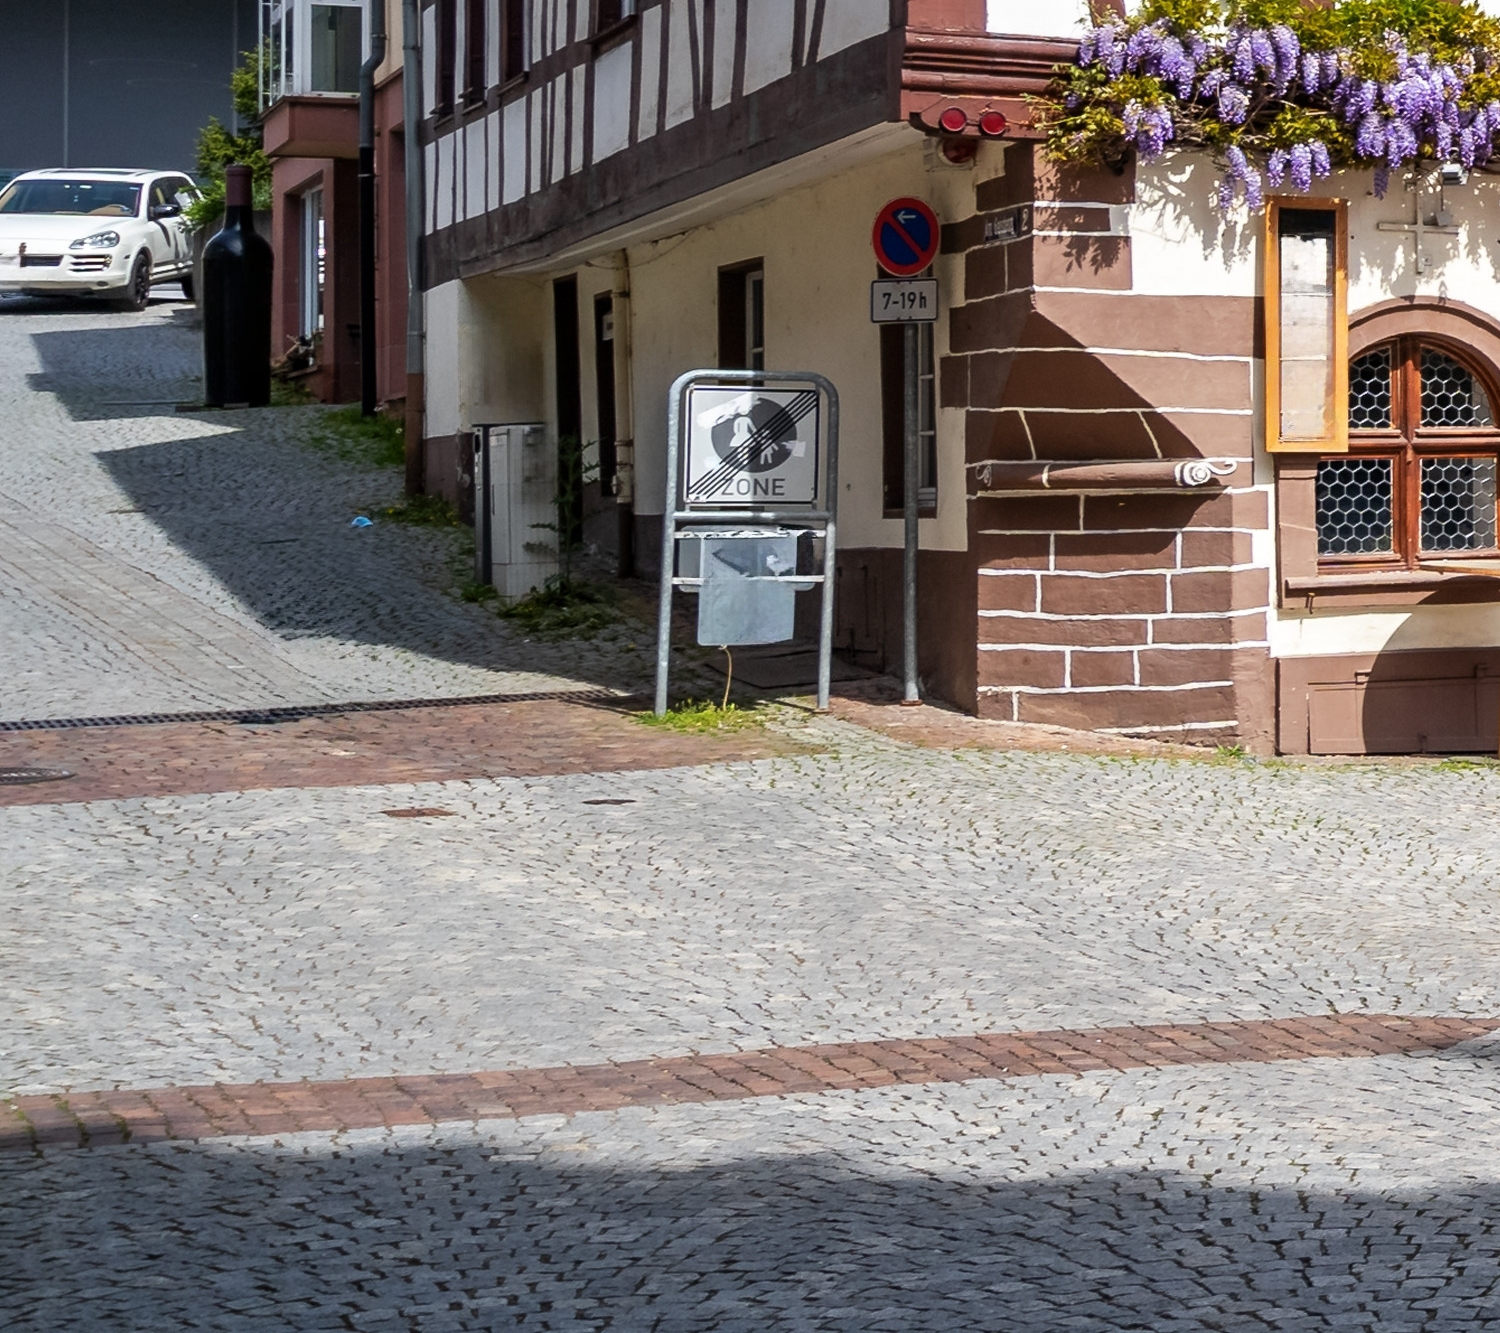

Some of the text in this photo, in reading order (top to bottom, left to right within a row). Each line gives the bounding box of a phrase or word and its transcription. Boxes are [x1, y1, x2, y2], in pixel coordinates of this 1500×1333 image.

[882, 291, 927, 310] 7-19 h
[721, 478, 785, 496] ZONE
